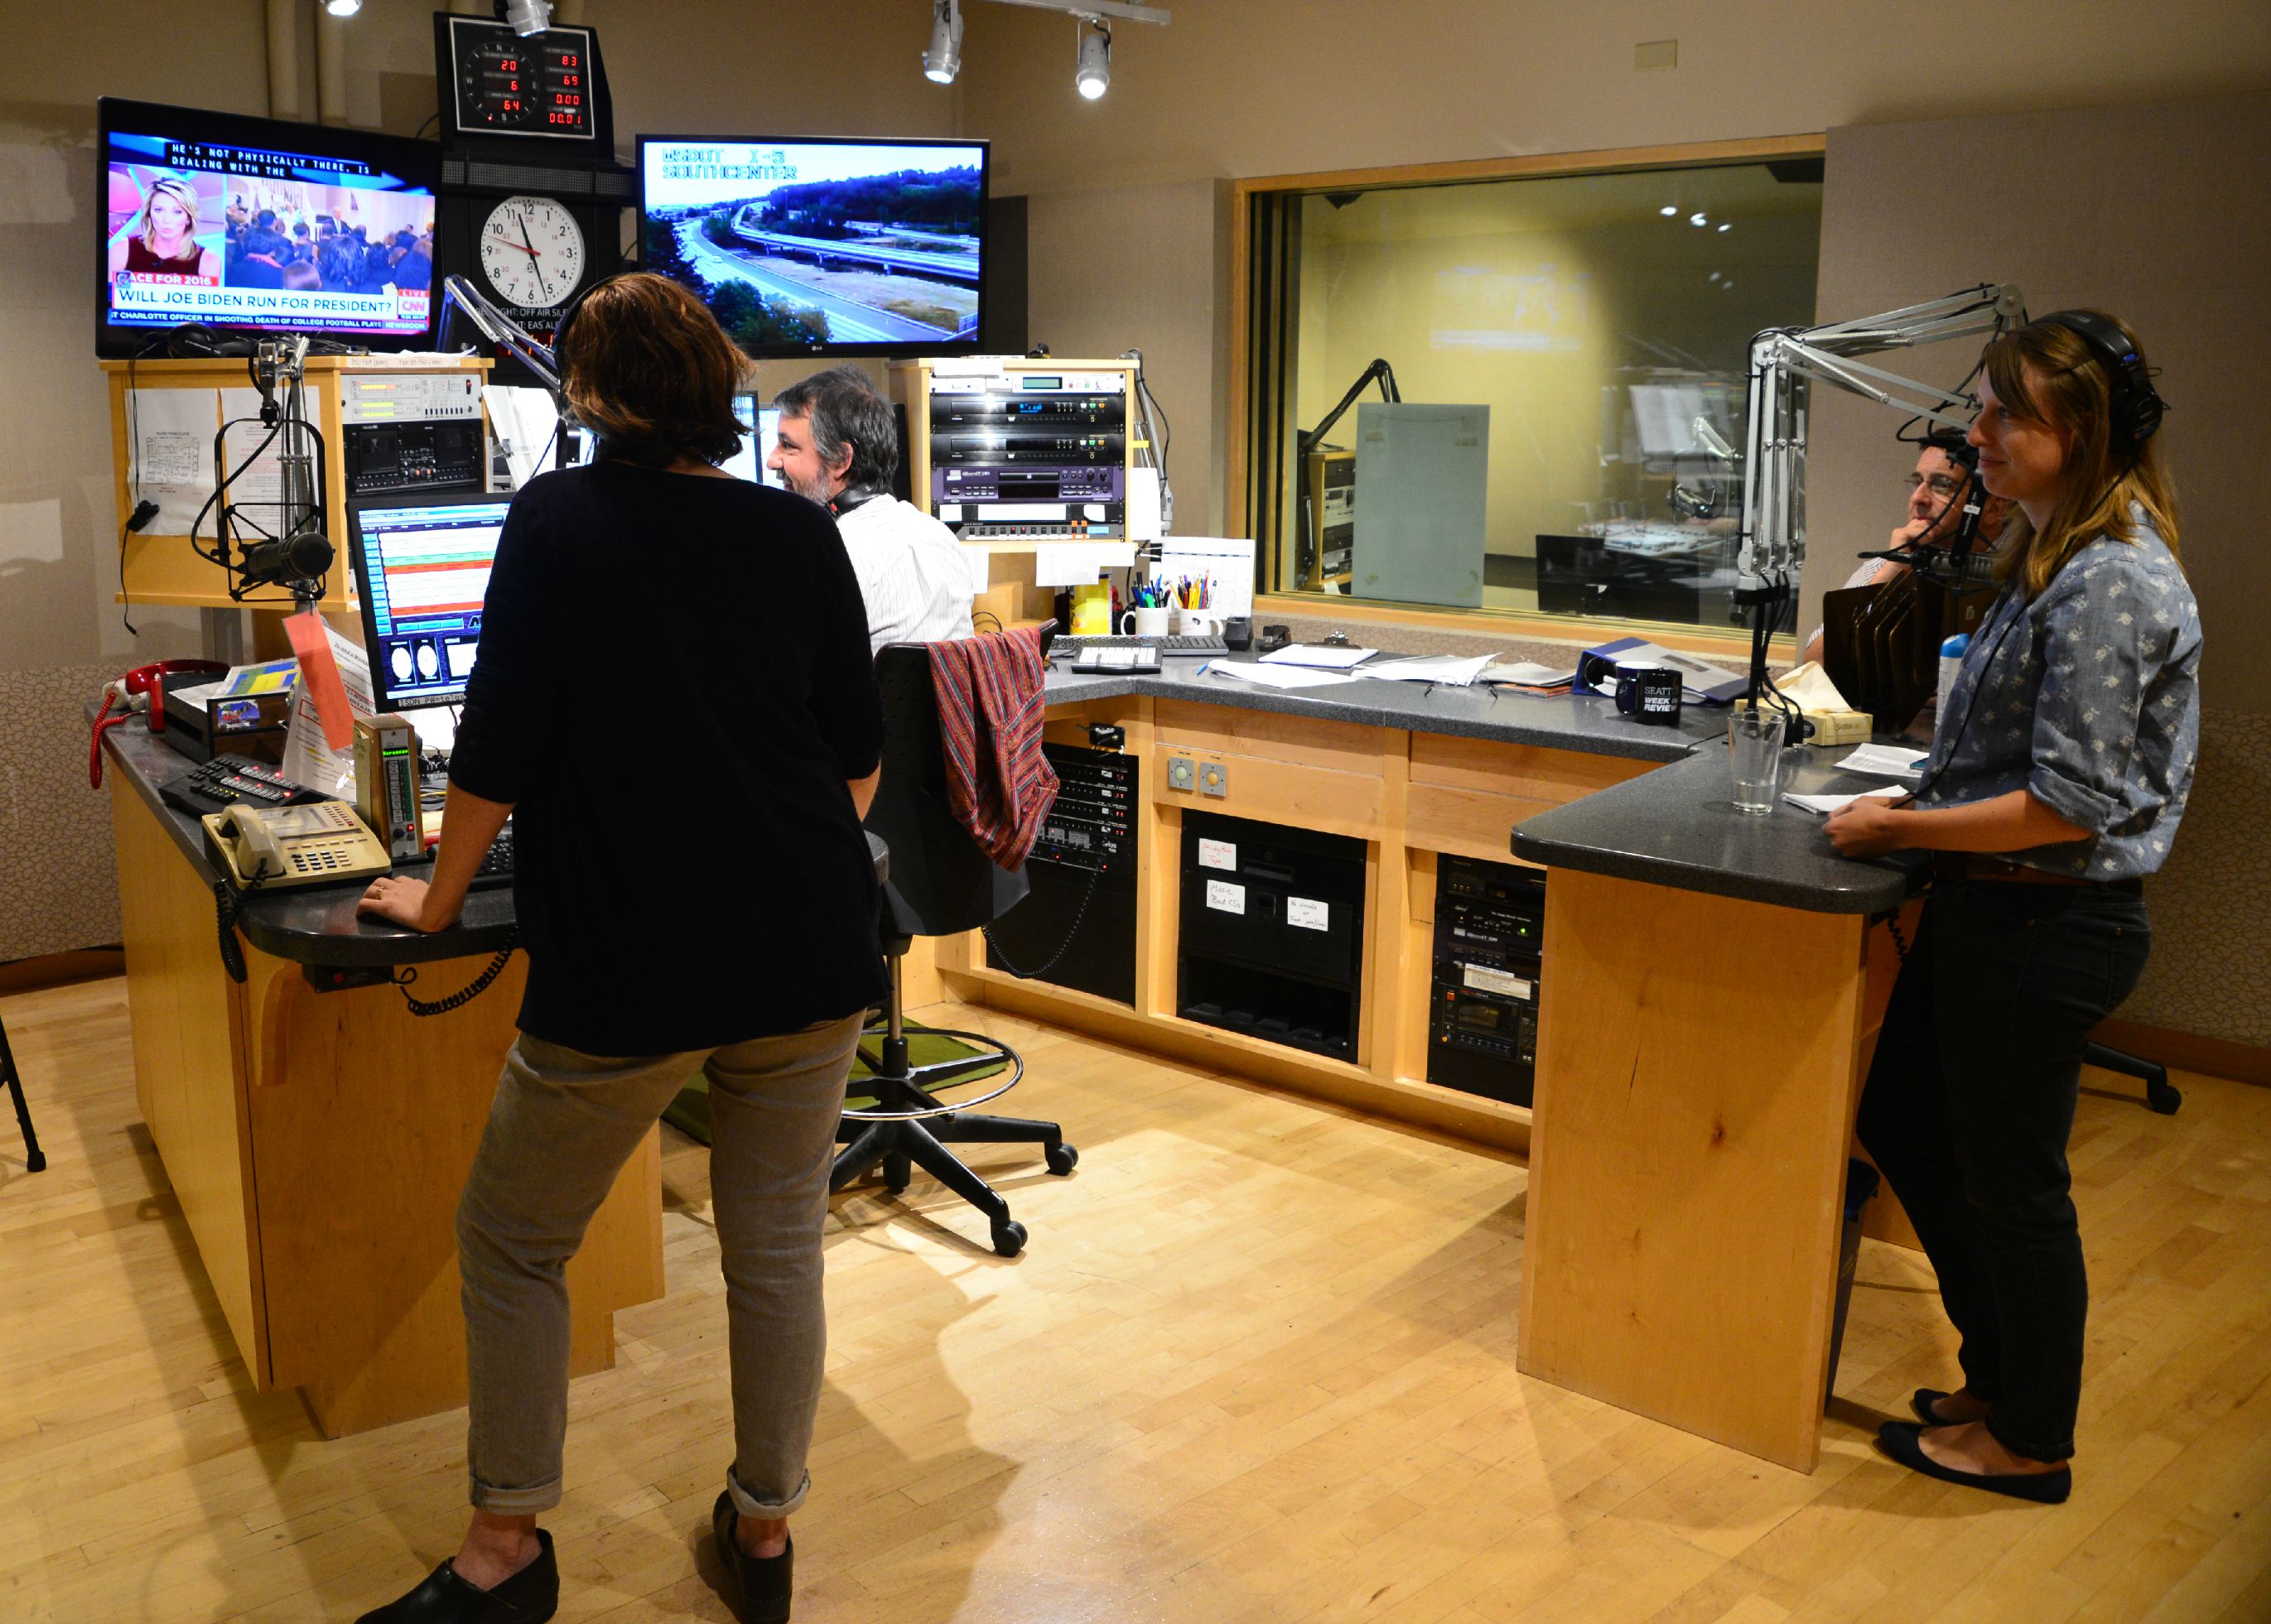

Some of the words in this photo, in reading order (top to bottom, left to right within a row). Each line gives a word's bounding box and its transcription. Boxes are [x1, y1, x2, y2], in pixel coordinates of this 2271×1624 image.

[501, 60, 517, 71] 20
[562, 55, 577, 66] 83
[511, 80, 518, 91] 6
[564, 75, 578, 86] 69
[504, 100, 519, 111] 64
[209, 147, 230, 158] NOT
[238, 151, 306, 167] PHYSICALLY
[359, 165, 369, 175] IS
[662, 148, 724, 163] WSDOT
[171, 156, 223, 170] DEALING
[229, 162, 258, 174] WITH
[266, 166, 285, 176] THE
[663, 164, 798, 180] SOUTHCENTER
[506, 209, 515, 219] 11
[523, 204, 534, 214] 12
[546, 210, 550, 221] 1
[492, 224, 504, 234] 10
[559, 226, 566, 236] 2
[486, 245, 493, 256] 9
[566, 248, 572, 258] 3
[494, 267, 500, 278] 8
[560, 269, 567, 279] 4
[129, 273, 153, 283] ACE
[156, 275, 181, 285] FOR
[184, 276, 211, 286] 2016
[509, 283, 514, 293] 7
[547, 283, 553, 294] 5
[528, 289, 534, 300] 6
[119, 290, 158, 302] WILL
[163, 292, 193, 304] JOE
[198, 293, 242, 306] BIDEN
[248, 296, 277, 307] RUN
[282, 297, 309, 308] FOR
[314, 299, 391, 312] PRESIDENT?
[402, 301, 426, 312] CNN
[520, 308, 535, 316] OFF
[119, 311, 168, 320] CHARLOTTE
[169, 313, 203, 321] OFFICER
[215, 316, 253, 324] SHOOTING
[292, 318, 324, 326] COLLEGE
[325, 319, 360, 327] FOOTBALL
[385, 321, 426, 330] NEWSROOM
[528, 320, 543, 330] EAS
[401, 698, 421, 706] ISDN
[1644, 704, 1677, 712] REVIEW
[1211, 883, 1233, 894] Music
